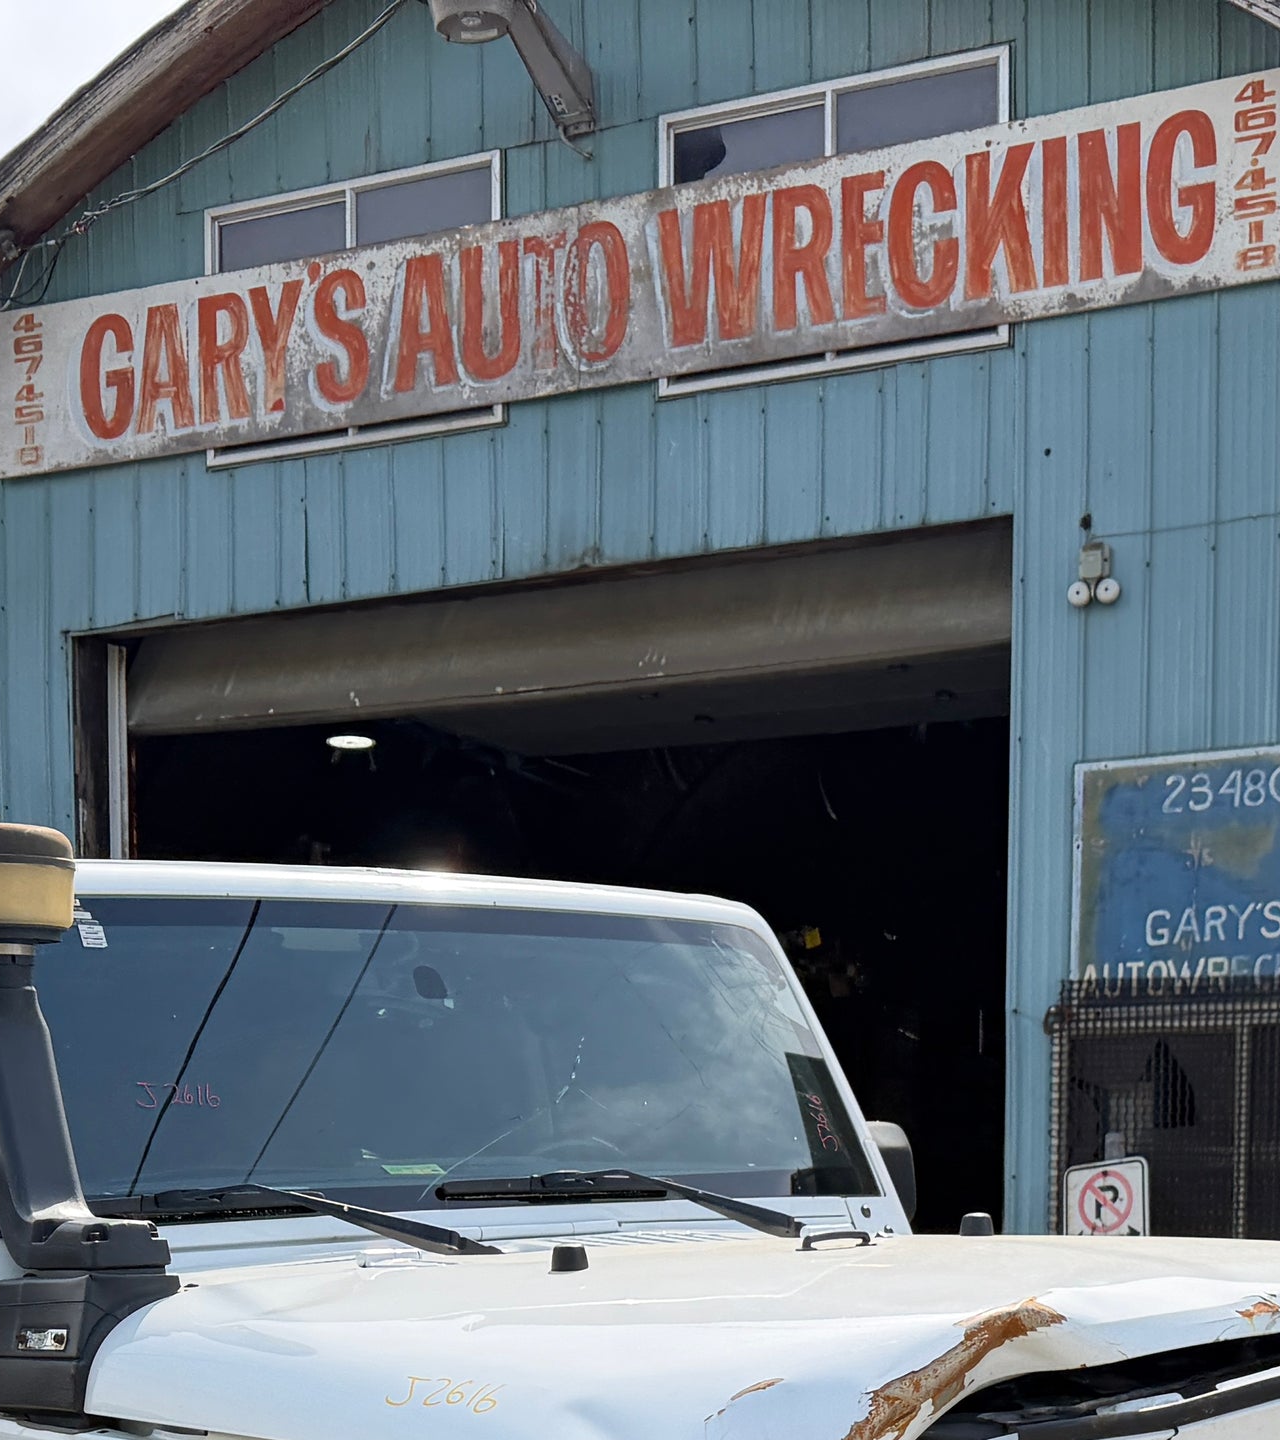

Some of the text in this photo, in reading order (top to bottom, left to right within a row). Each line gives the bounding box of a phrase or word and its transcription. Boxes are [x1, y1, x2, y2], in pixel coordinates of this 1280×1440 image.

[80, 109, 1218, 441] GARY'S AUTO WRECKING
